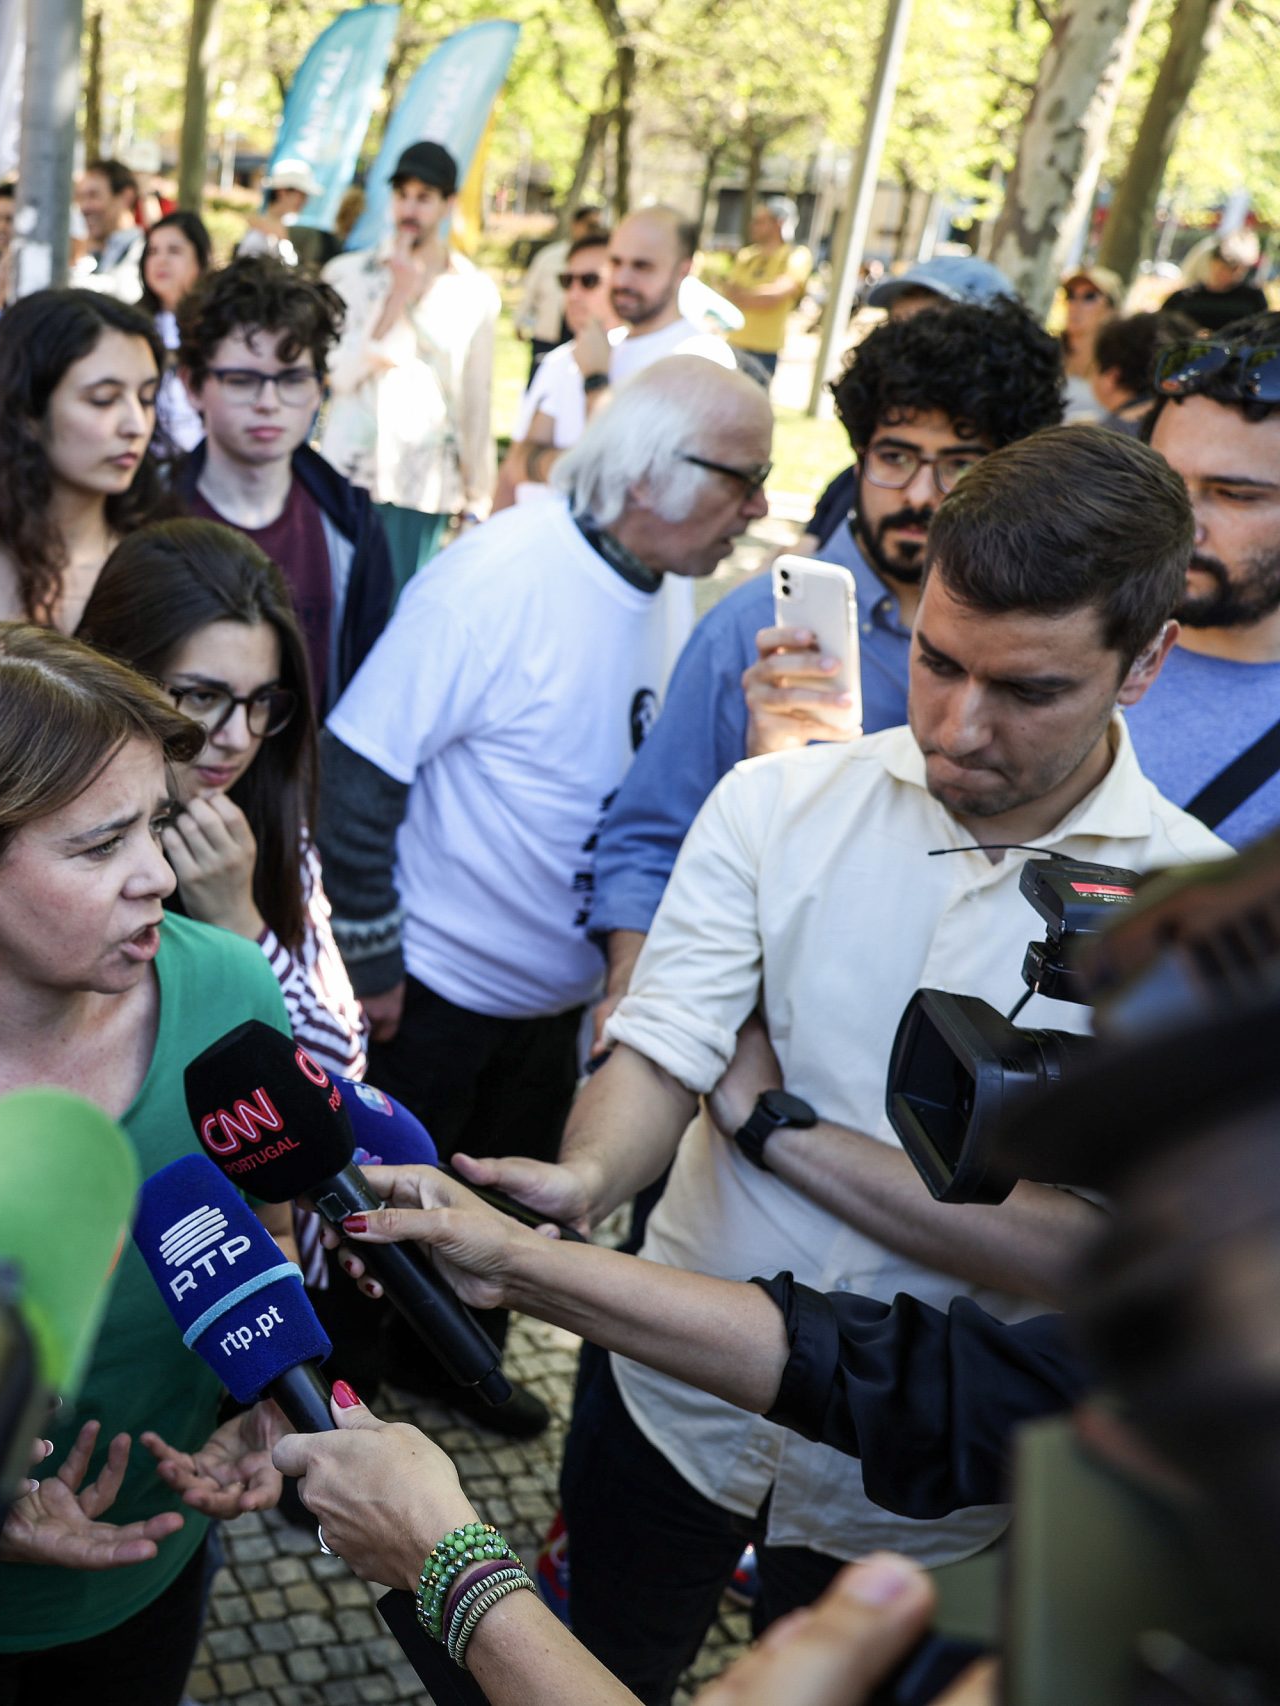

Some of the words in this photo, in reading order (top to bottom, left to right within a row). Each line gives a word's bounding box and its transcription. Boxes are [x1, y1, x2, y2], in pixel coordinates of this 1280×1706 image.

[200, 1086, 284, 1156] CNN
[224, 1136, 301, 1175] PORTUGAL
[169, 1235, 251, 1302] RTP
[220, 1305, 284, 1356] rtp.pt
